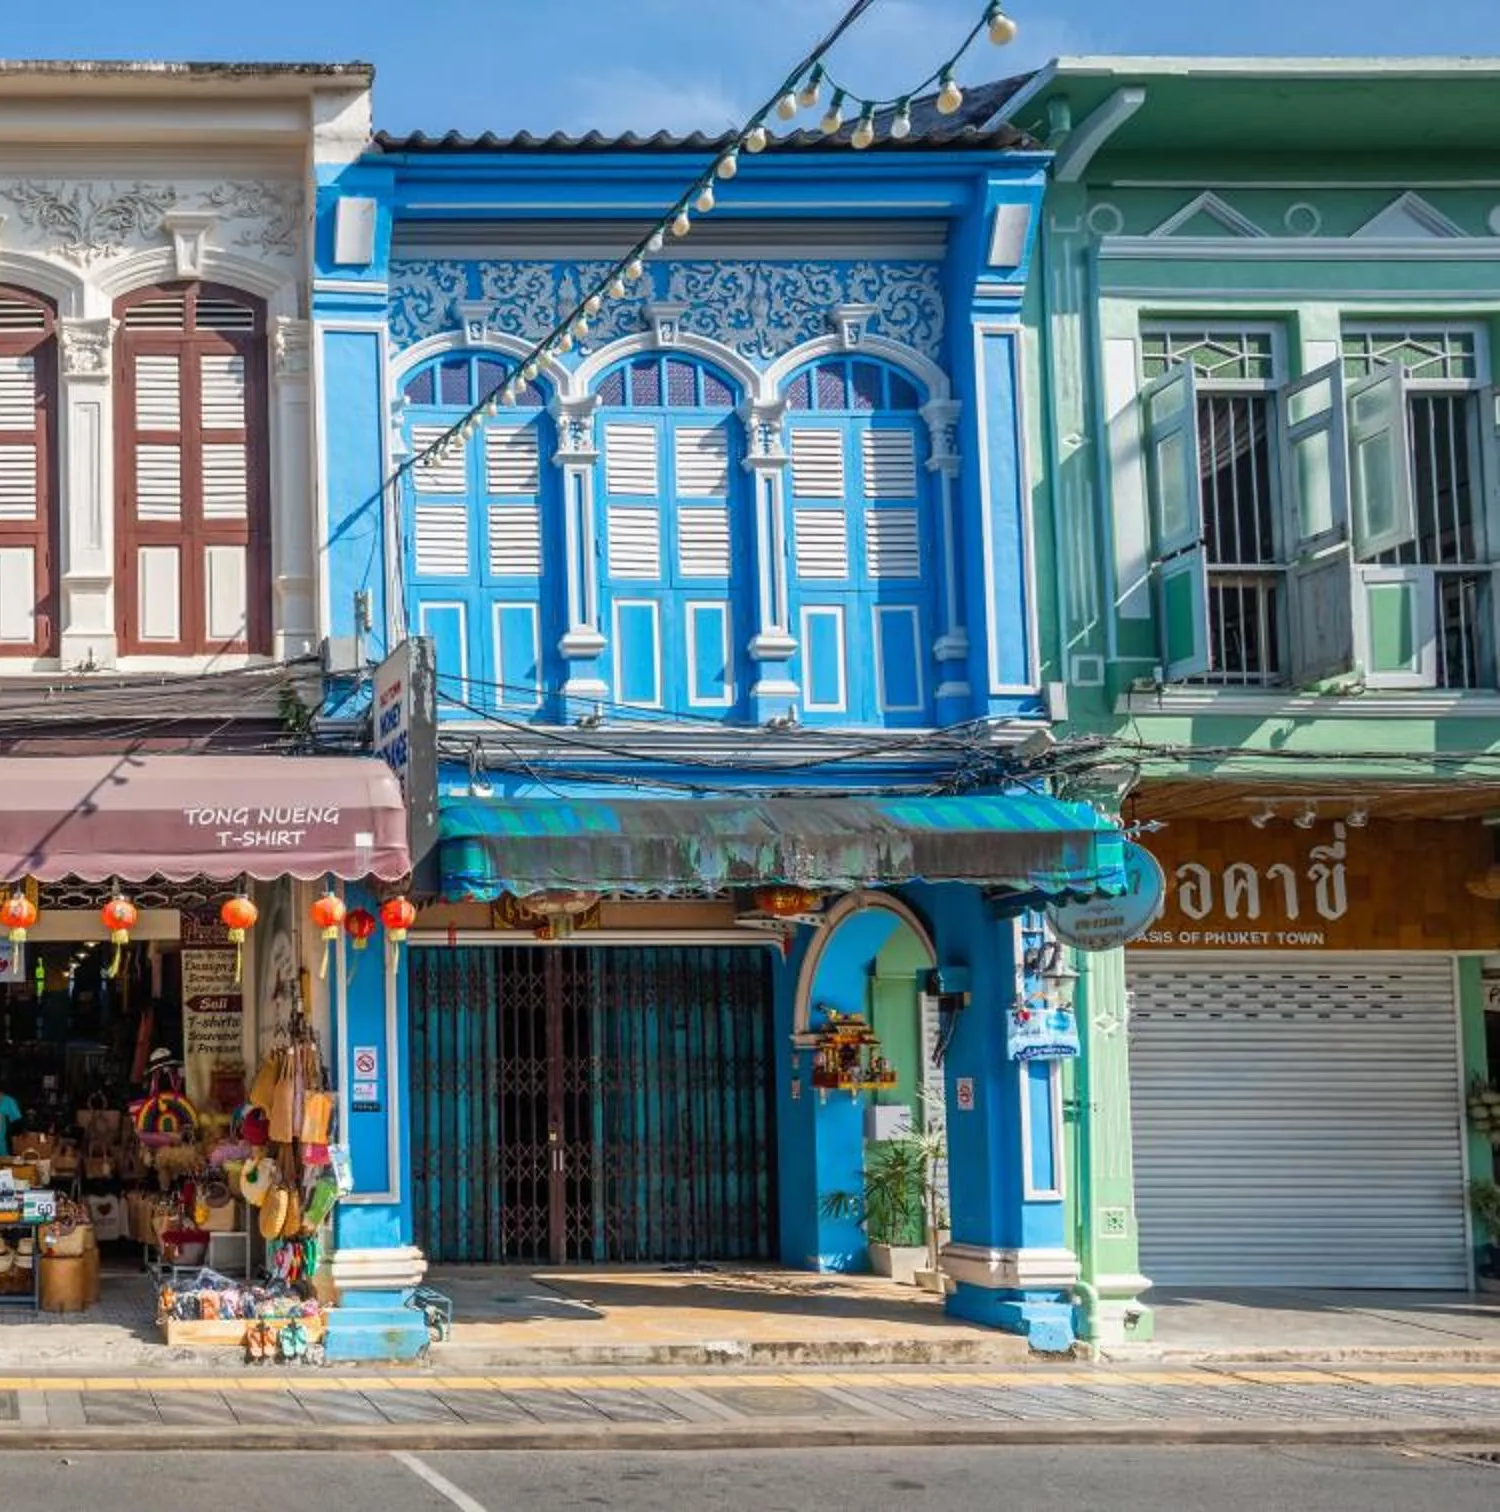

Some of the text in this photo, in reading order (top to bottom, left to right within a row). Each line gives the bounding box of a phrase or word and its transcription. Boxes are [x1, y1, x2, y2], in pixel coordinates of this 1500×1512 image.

[183, 806, 340, 825] TONG NUENG
[216, 830, 306, 847] T-SHIRT
[1155, 821, 1348, 921] อคาขี่
[1126, 931, 1173, 944] ASIS
[1179, 932, 1201, 944] OF
[1204, 932, 1270, 945] PHUKET
[1276, 932, 1325, 945] TOWN
